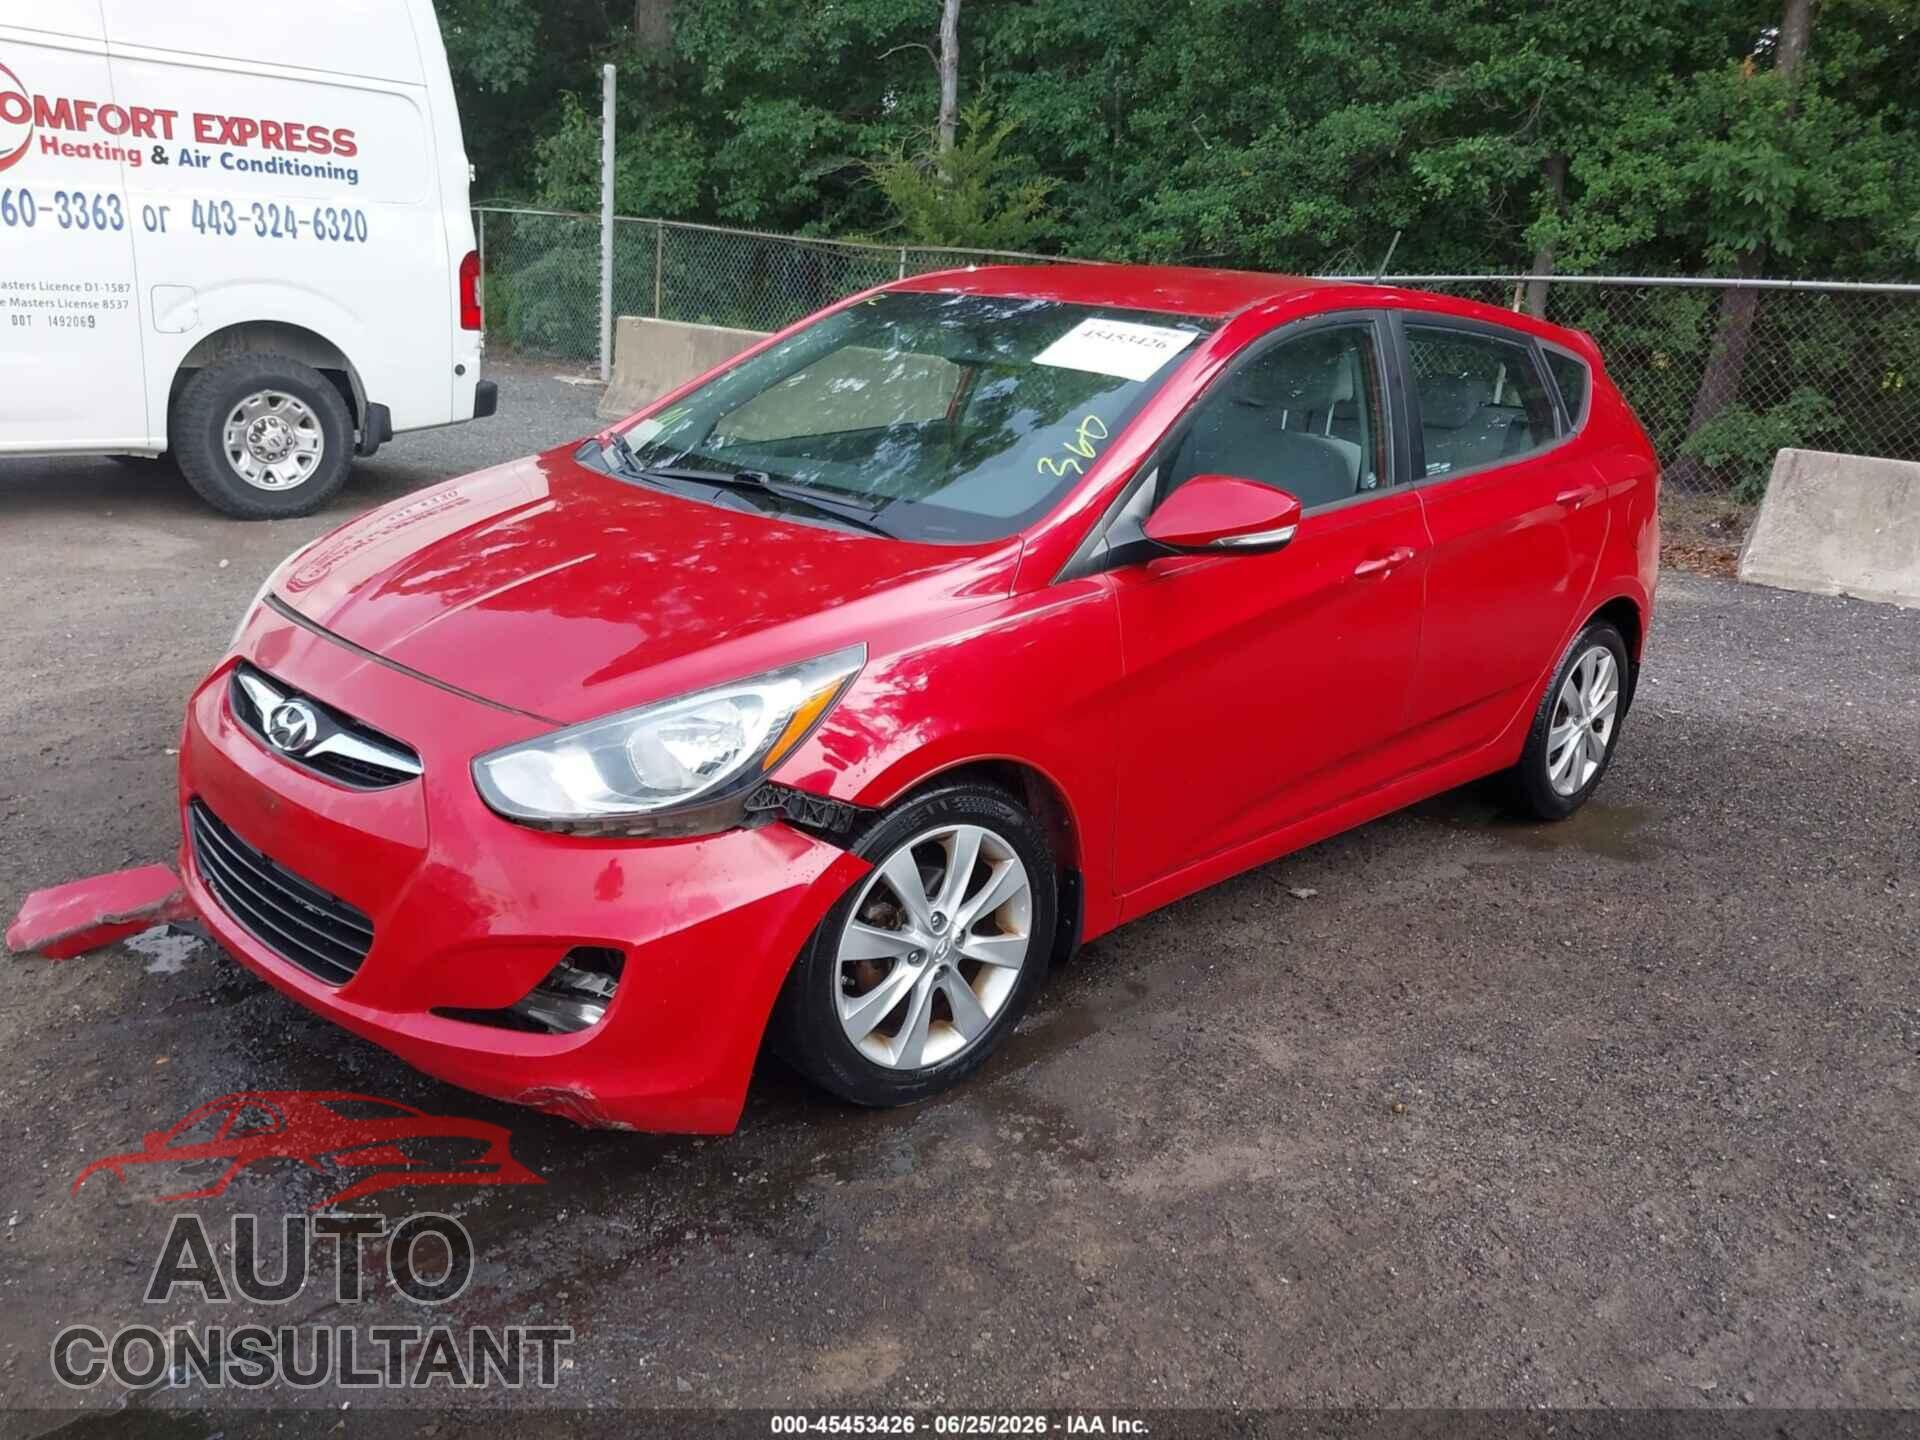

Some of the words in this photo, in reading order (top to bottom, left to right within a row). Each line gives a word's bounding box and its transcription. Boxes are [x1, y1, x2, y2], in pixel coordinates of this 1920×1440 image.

[0, 91, 178, 140] OMFORT
[193, 113, 358, 157] EXPRESS
[40, 135, 142, 167] Heating
[151, 145, 169, 165] &
[178, 148, 211, 168] Air
[220, 152, 359, 185] Conditioning
[1, 188, 124, 231] 60-3363
[143, 205, 170, 233] or
[192, 199, 368, 243] 443-324-6320
[9, 297, 56, 308] Masters
[57, 298, 101, 309] License
[39, 282, 82, 292] Licence
[84, 282, 131, 293] D1-1587
[48, 315, 96, 328] 1492069
